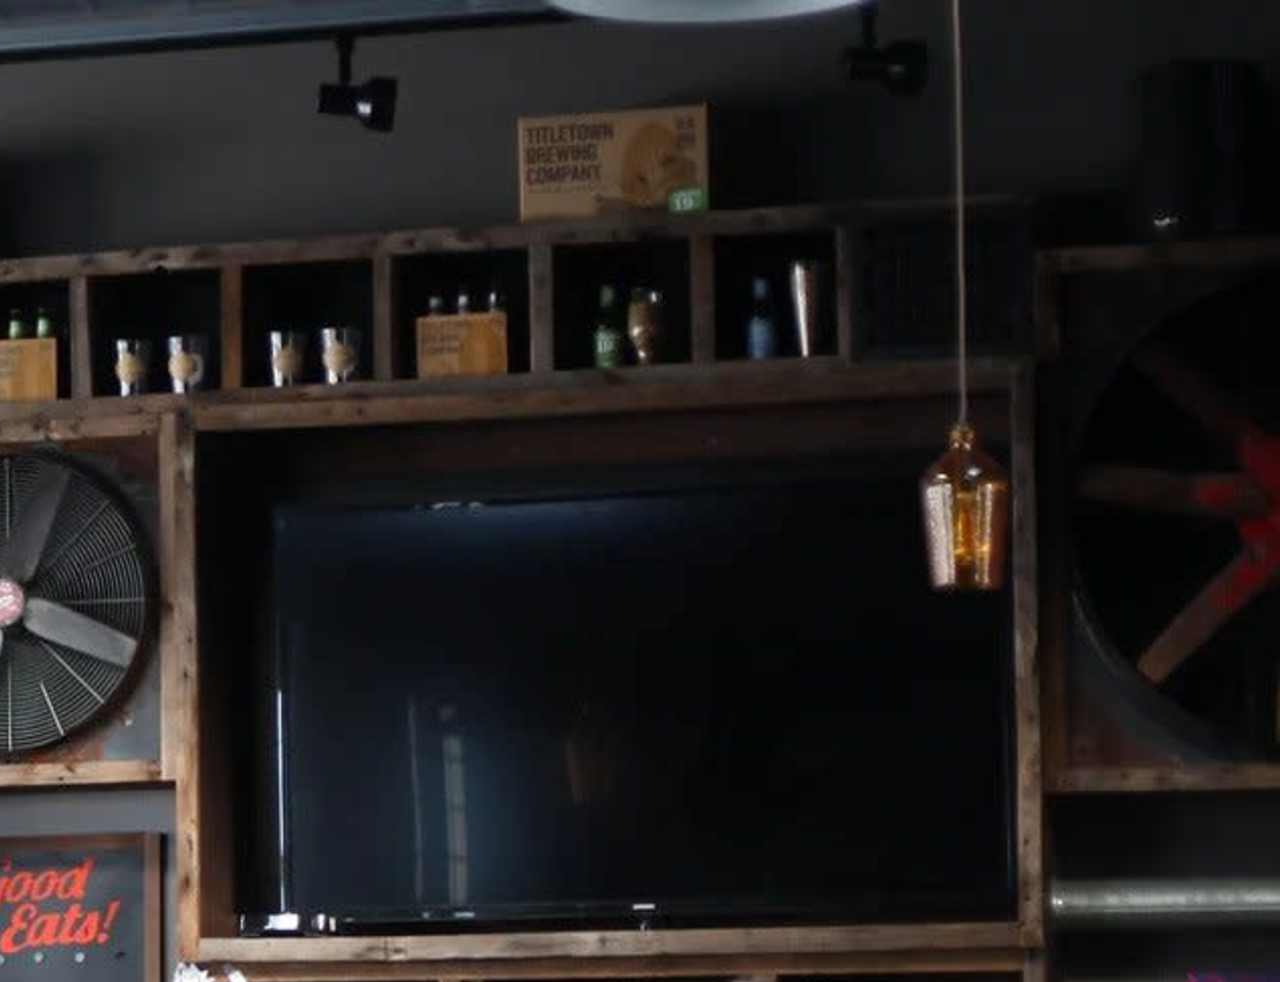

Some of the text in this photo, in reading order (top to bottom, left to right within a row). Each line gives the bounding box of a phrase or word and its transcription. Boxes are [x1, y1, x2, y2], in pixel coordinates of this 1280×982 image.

[525, 123, 615, 145] TITLETOWN
[526, 143, 598, 165] BREWING
[526, 164, 601, 186] COMPANY
[0, 898, 122, 954] Eats!
